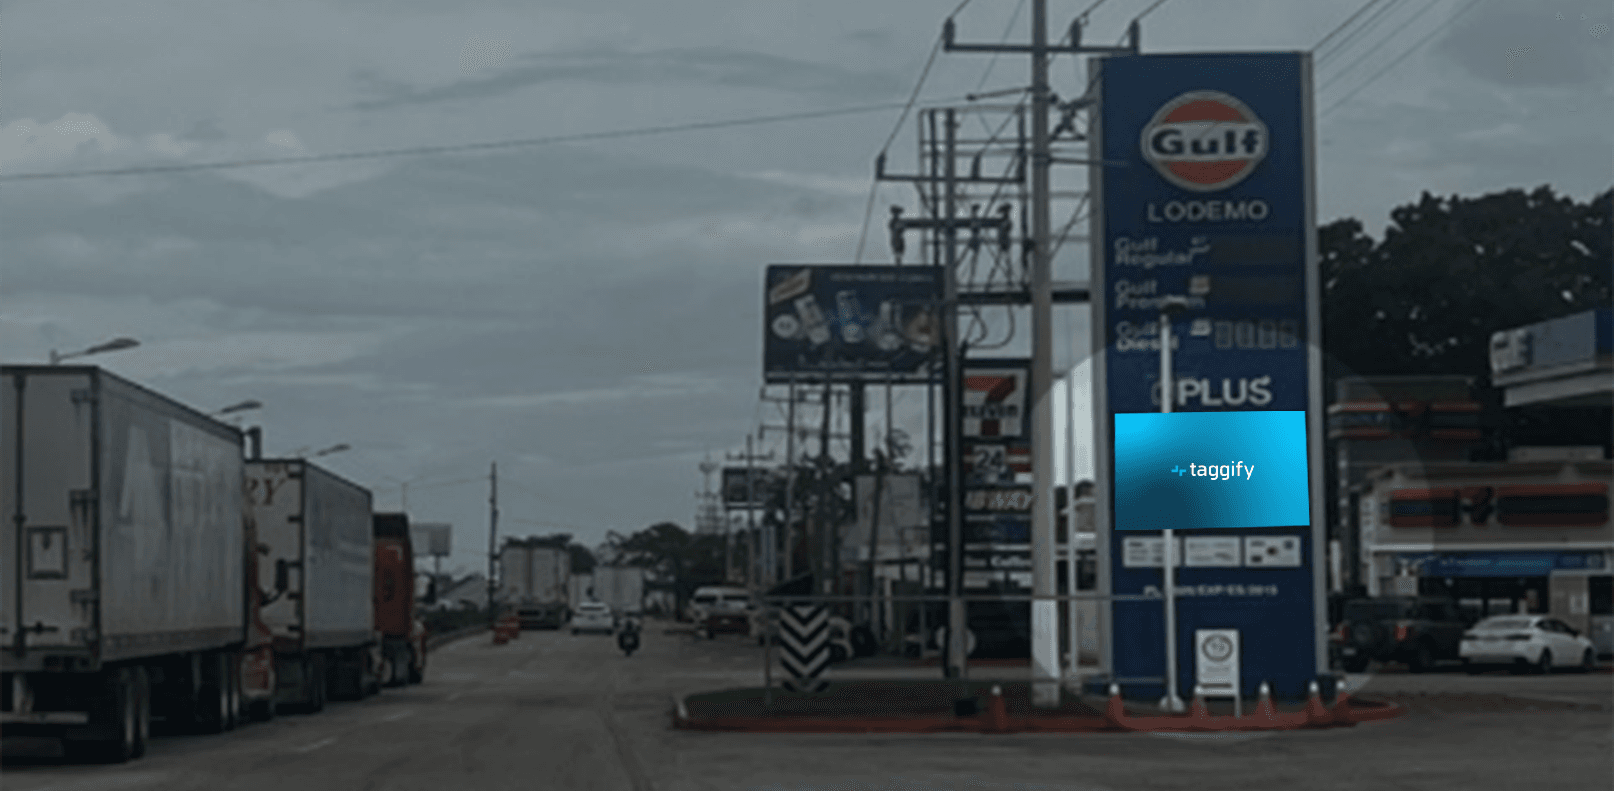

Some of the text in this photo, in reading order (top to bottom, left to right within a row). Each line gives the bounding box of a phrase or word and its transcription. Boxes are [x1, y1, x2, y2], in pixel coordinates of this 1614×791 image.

[1151, 128, 1259, 156] Gulf
[1148, 200, 1268, 222] LODEMO
[1115, 237, 1158, 252] Gulf
[1115, 249, 1193, 269] Regular
[1115, 279, 1158, 294] Gulf
[1115, 293, 1206, 309] Premm
[1116, 320, 1159, 336] Gulf
[1116, 335, 1179, 352] Diesl
[975, 449, 1004, 469] 24
[1190, 460, 1255, 481] taggify
